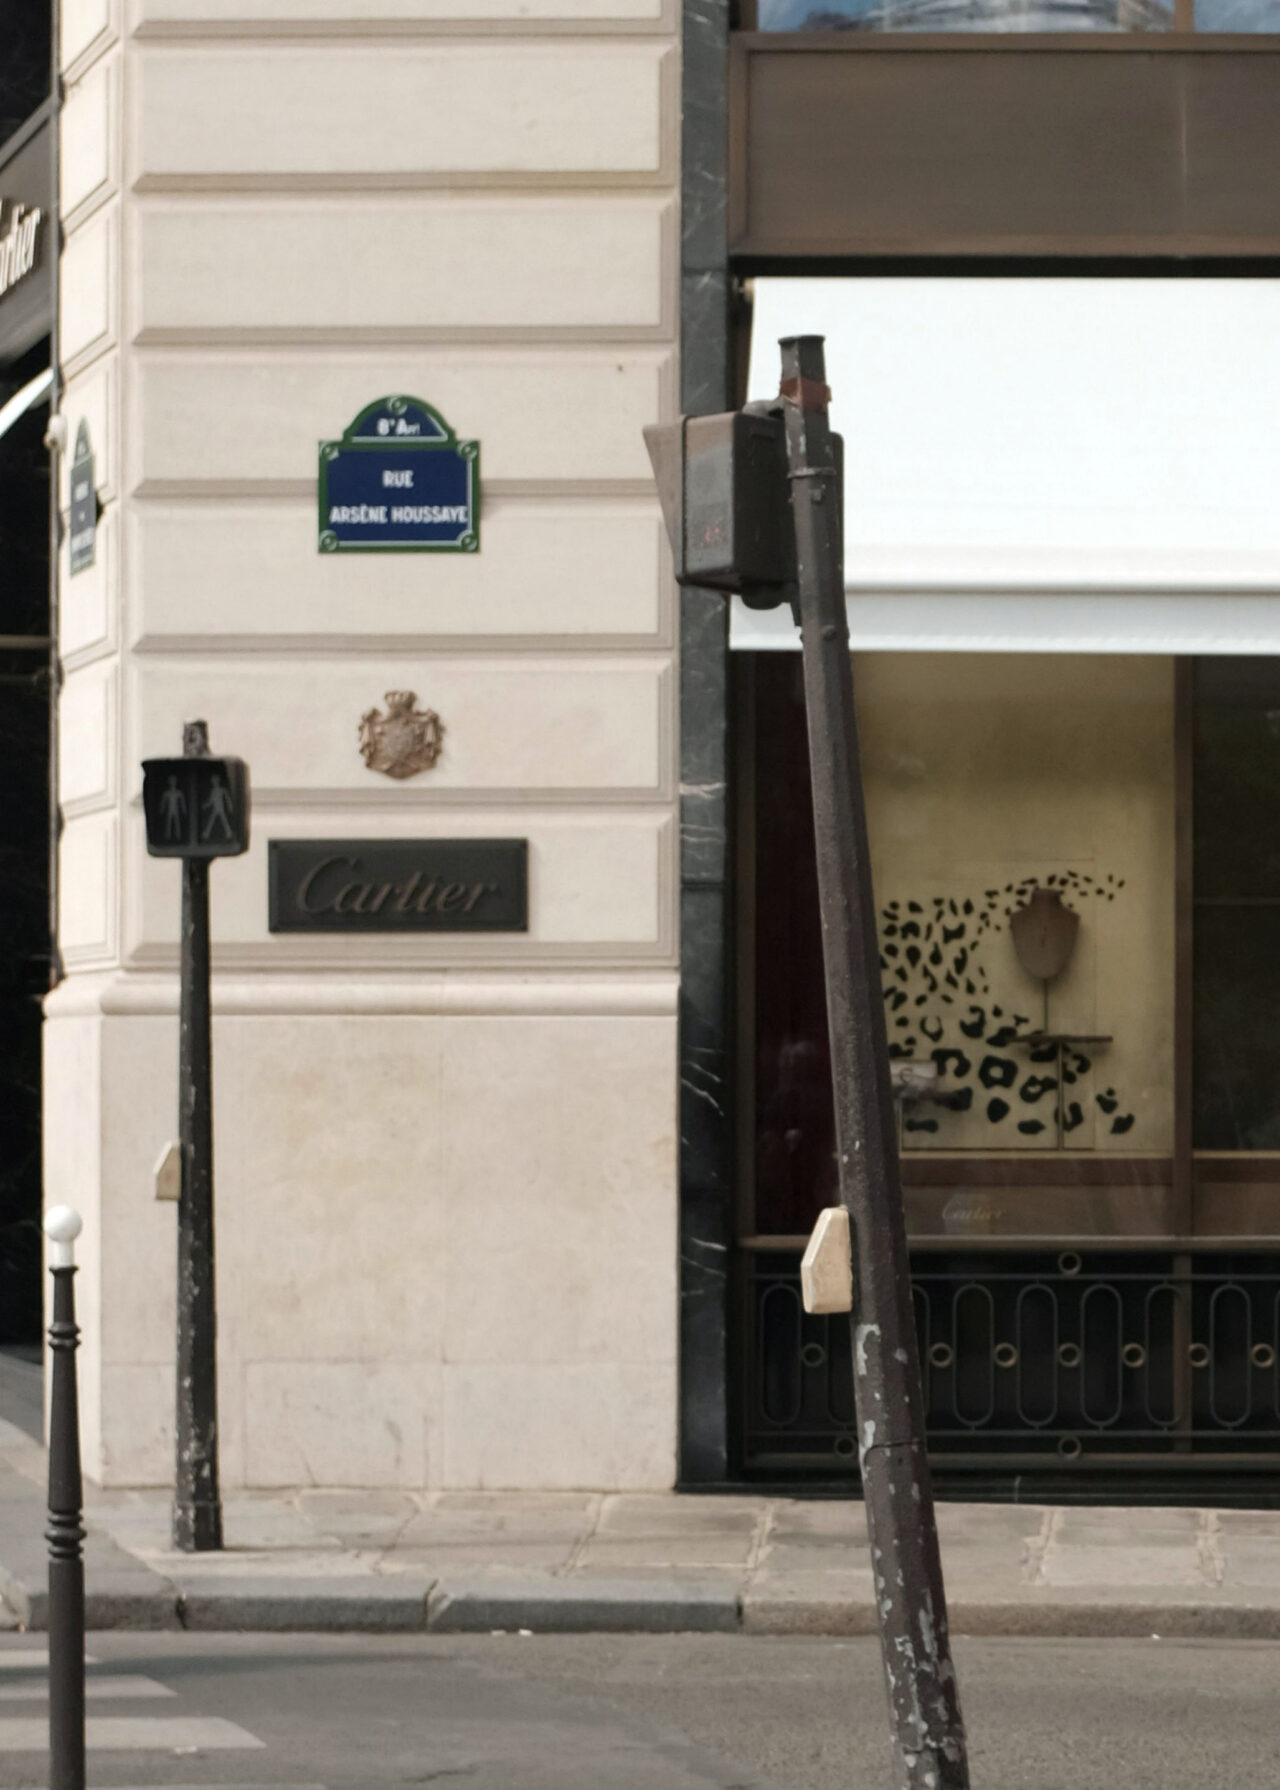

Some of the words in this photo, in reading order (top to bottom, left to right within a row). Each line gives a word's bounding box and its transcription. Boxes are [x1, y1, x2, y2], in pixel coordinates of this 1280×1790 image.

[0, 199, 41, 296] rtier
[382, 470, 414, 488] RUE
[330, 503, 388, 523] ARSÈNE
[391, 505, 468, 523] HOUSSAYE
[297, 855, 497, 914] Cartier
